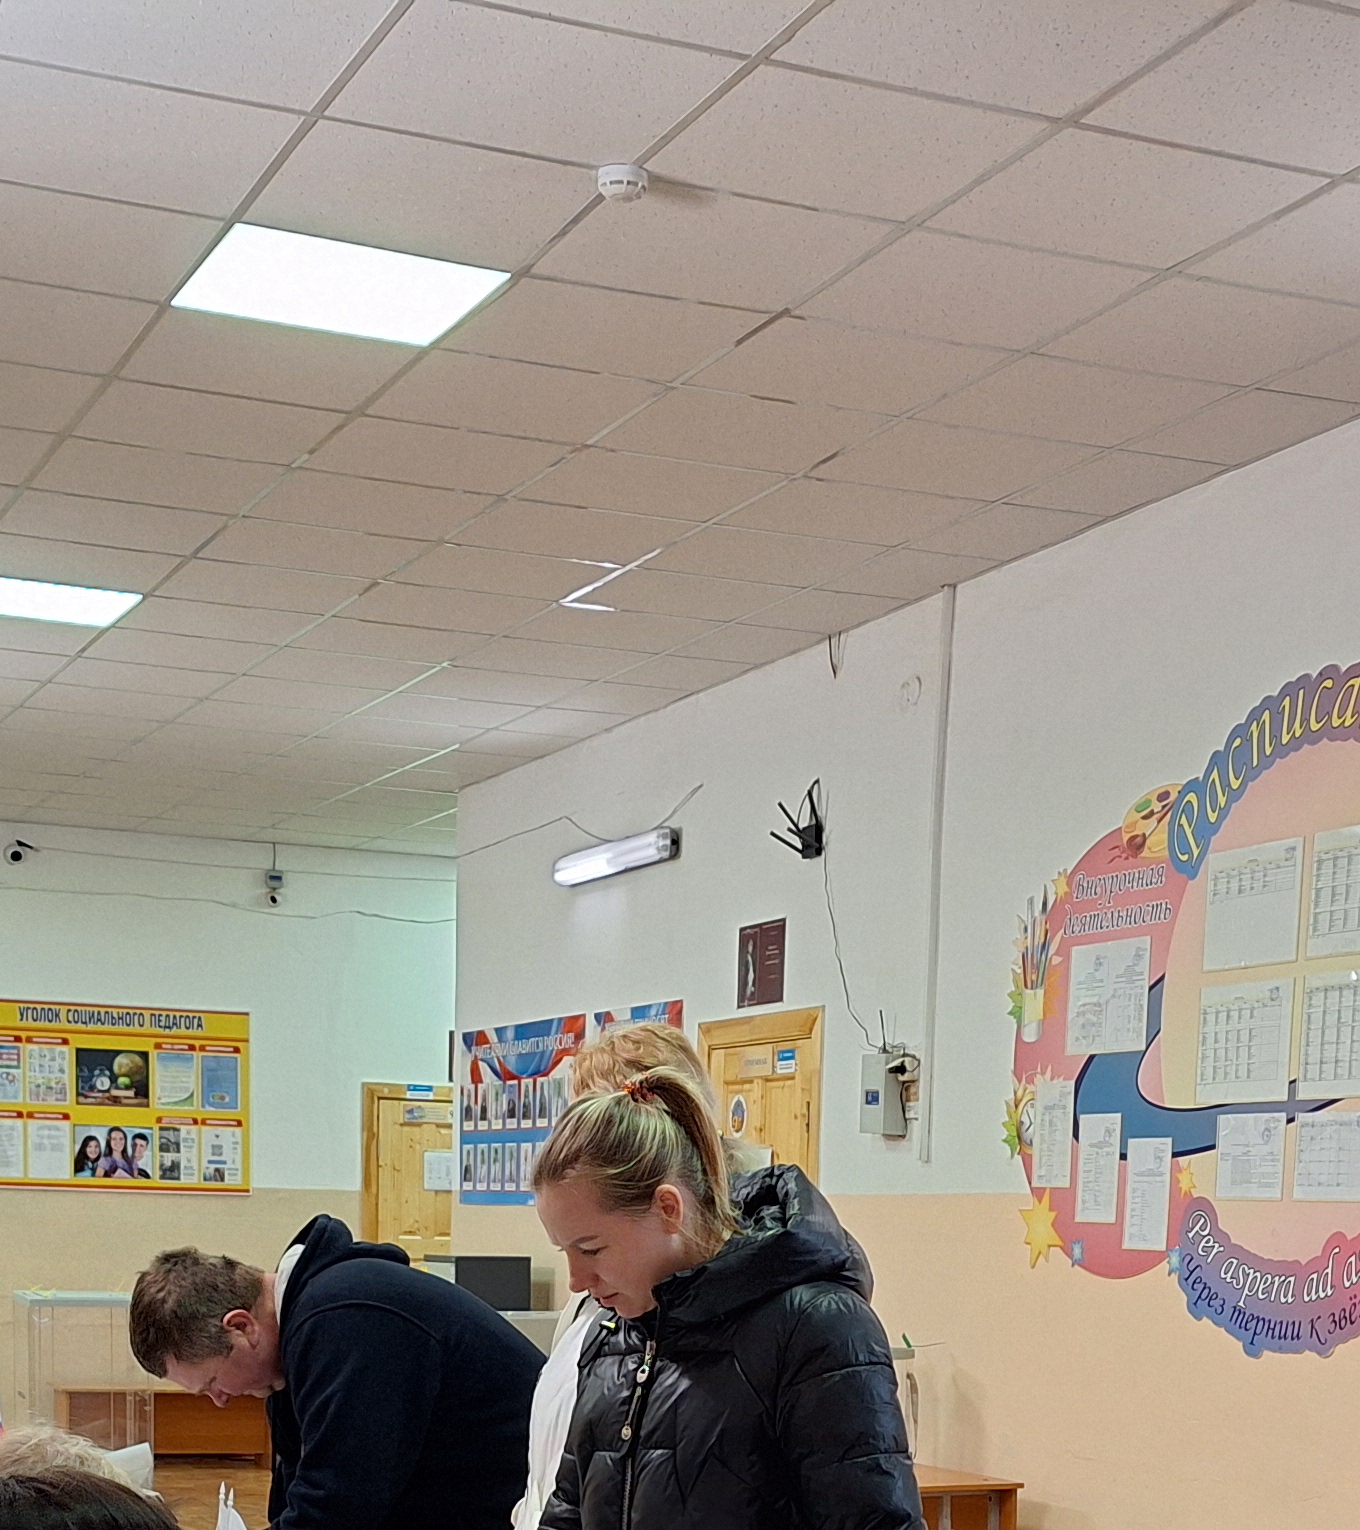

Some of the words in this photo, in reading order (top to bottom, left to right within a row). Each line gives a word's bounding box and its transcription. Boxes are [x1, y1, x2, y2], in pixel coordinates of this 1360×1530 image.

[1074, 864, 1165, 906] Внеурочная
[1063, 900, 1172, 937] деятельность
[18, 1005, 61, 1023] УГОЛОК
[66, 1008, 145, 1029] СОЦИАЛЬНОГО
[150, 1012, 203, 1032] ПЕДАГОГА
[1186, 1210, 1224, 1264] Per
[1220, 1256, 1295, 1308] aspera
[1303, 1246, 1340, 1303] ad
[1182, 1253, 1226, 1316] Через
[1229, 1304, 1302, 1346] тернии
